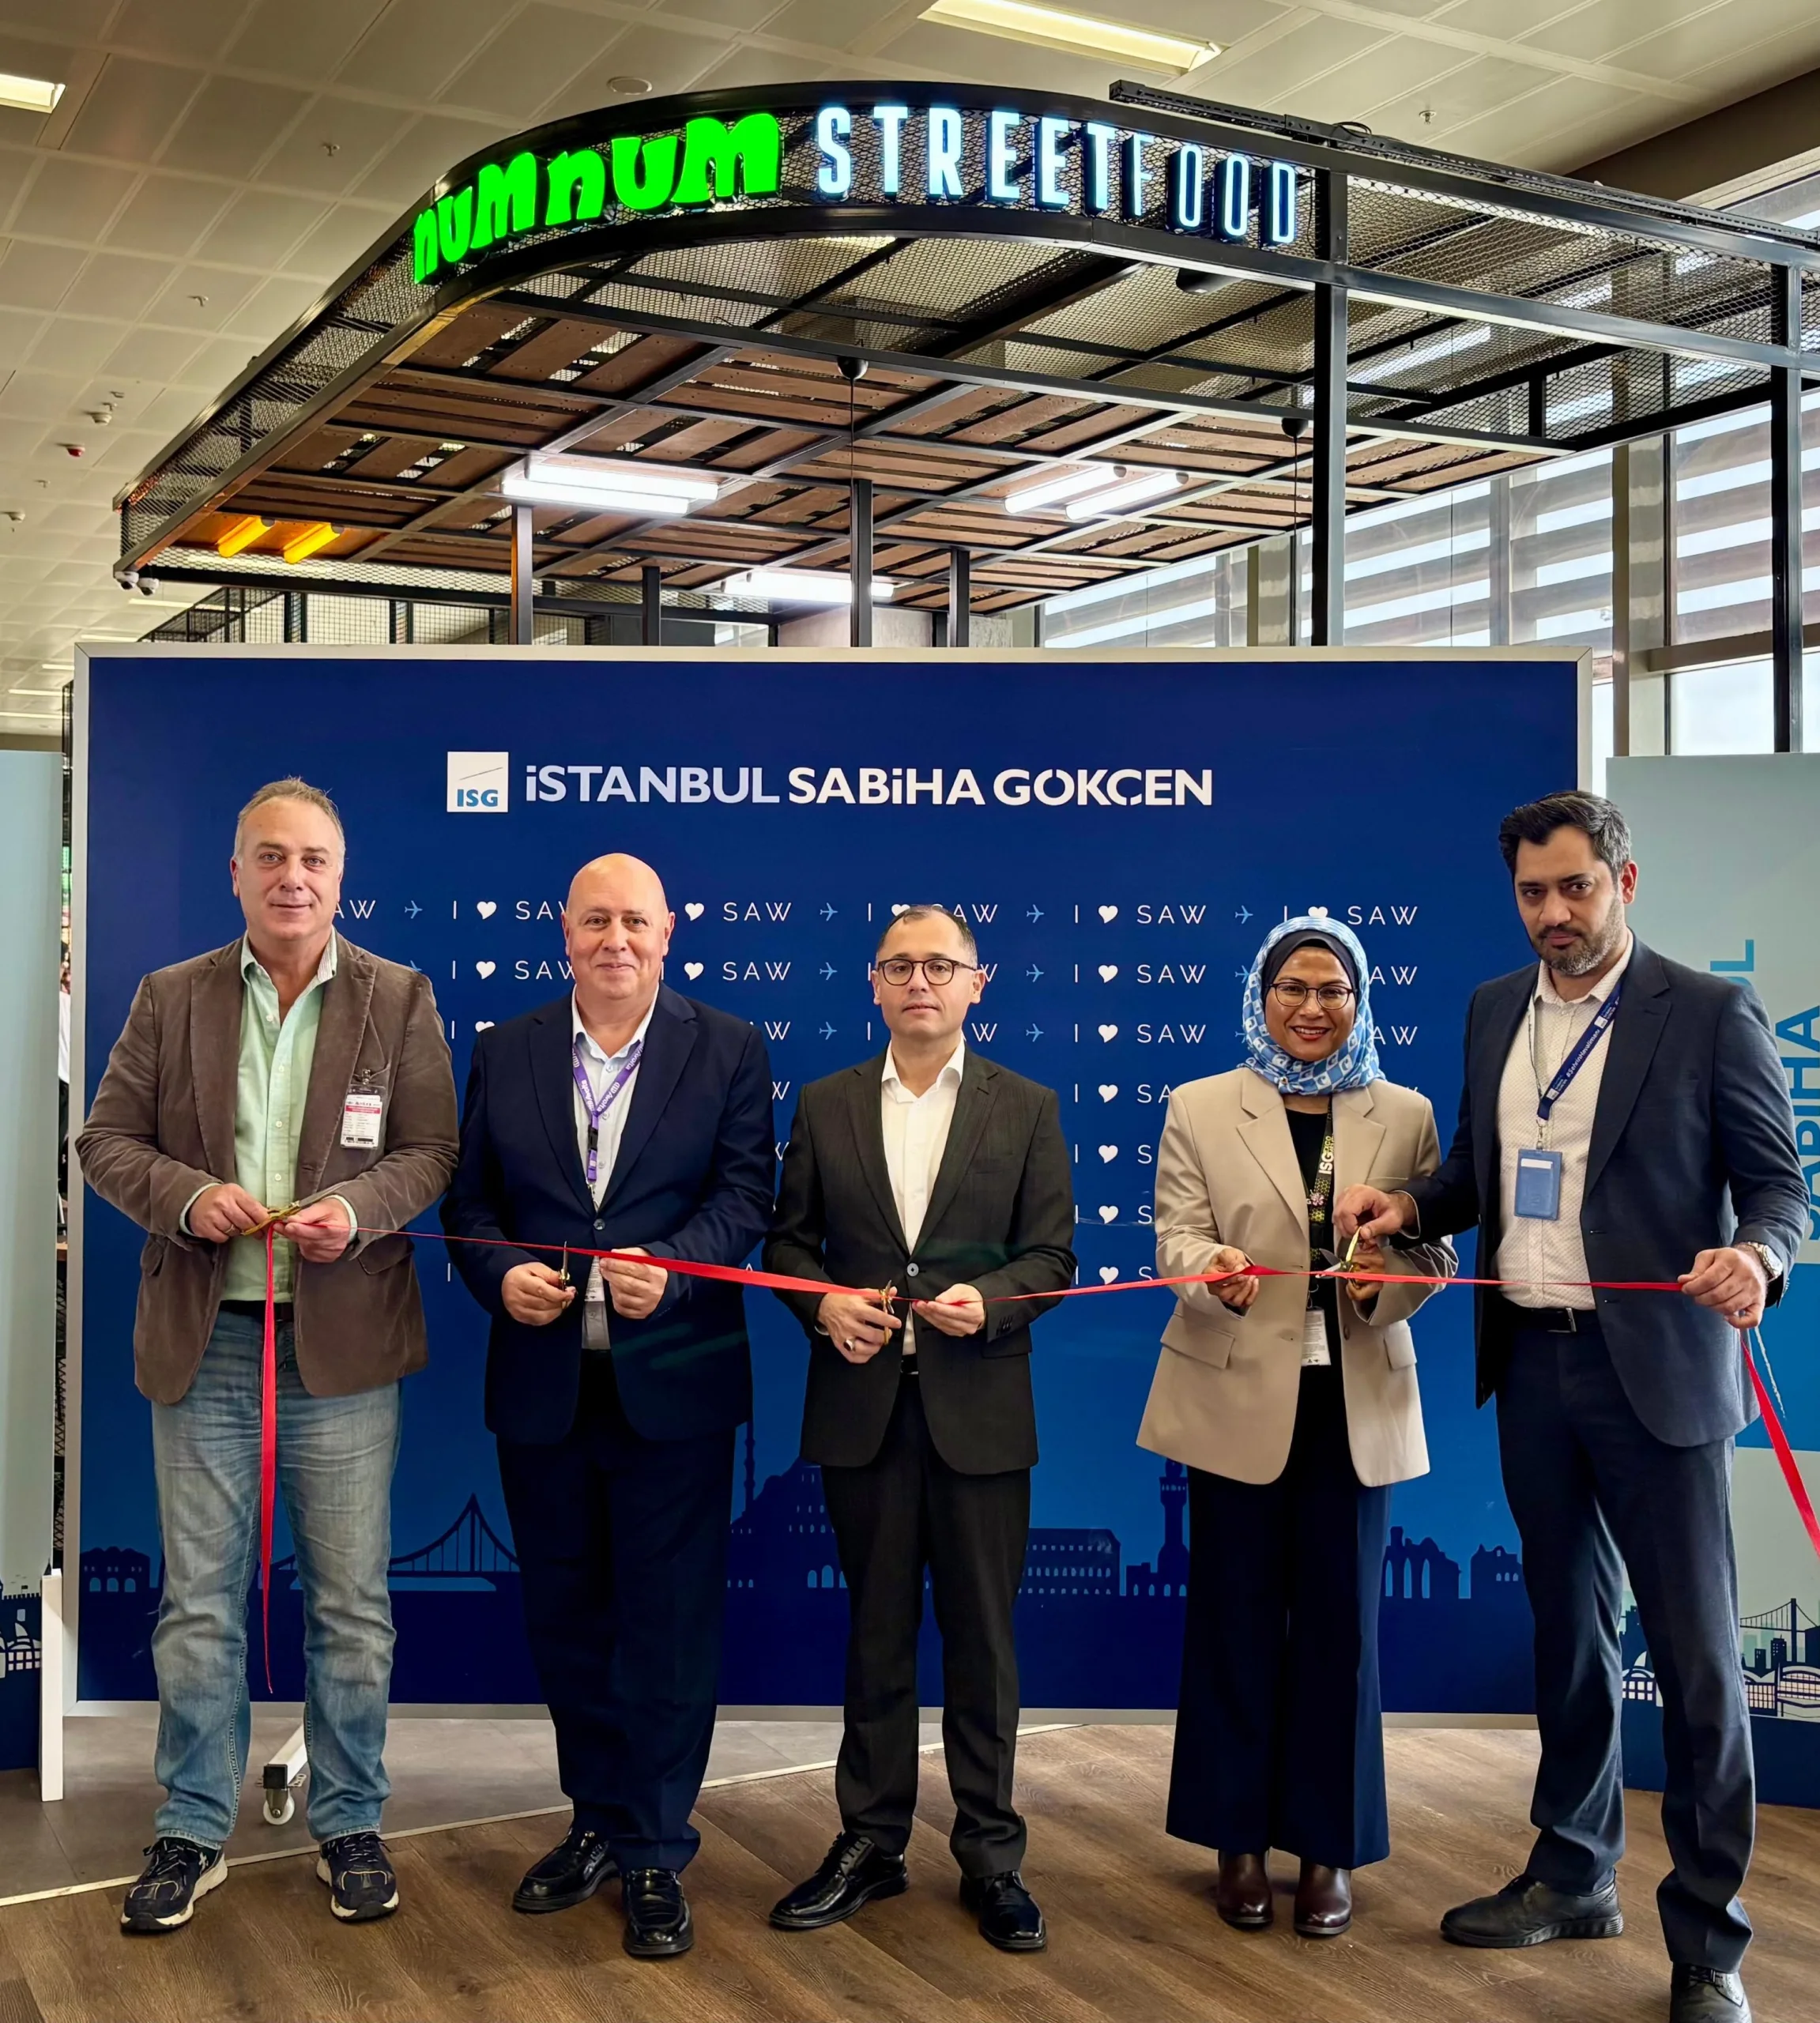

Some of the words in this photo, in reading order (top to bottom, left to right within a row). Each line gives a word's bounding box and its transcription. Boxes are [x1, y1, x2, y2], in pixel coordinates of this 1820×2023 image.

[457, 789, 499, 807] ISG
[333, 899, 376, 920] AW
[515, 900, 567, 920] SA
[723, 902, 792, 921] SAW
[932, 903, 998, 923] AW
[1136, 905, 1206, 925] SAW
[1347, 906, 1418, 925] SAW
[722, 961, 791, 981] SAW
[1137, 964, 1206, 984] SAW
[1369, 966, 1418, 985] AW
[1137, 1023, 1206, 1044] SAW
[1373, 1026, 1418, 1045] AW
[1137, 1083, 1171, 1103] SA
[1318, 1152, 1334, 1174] ISG
